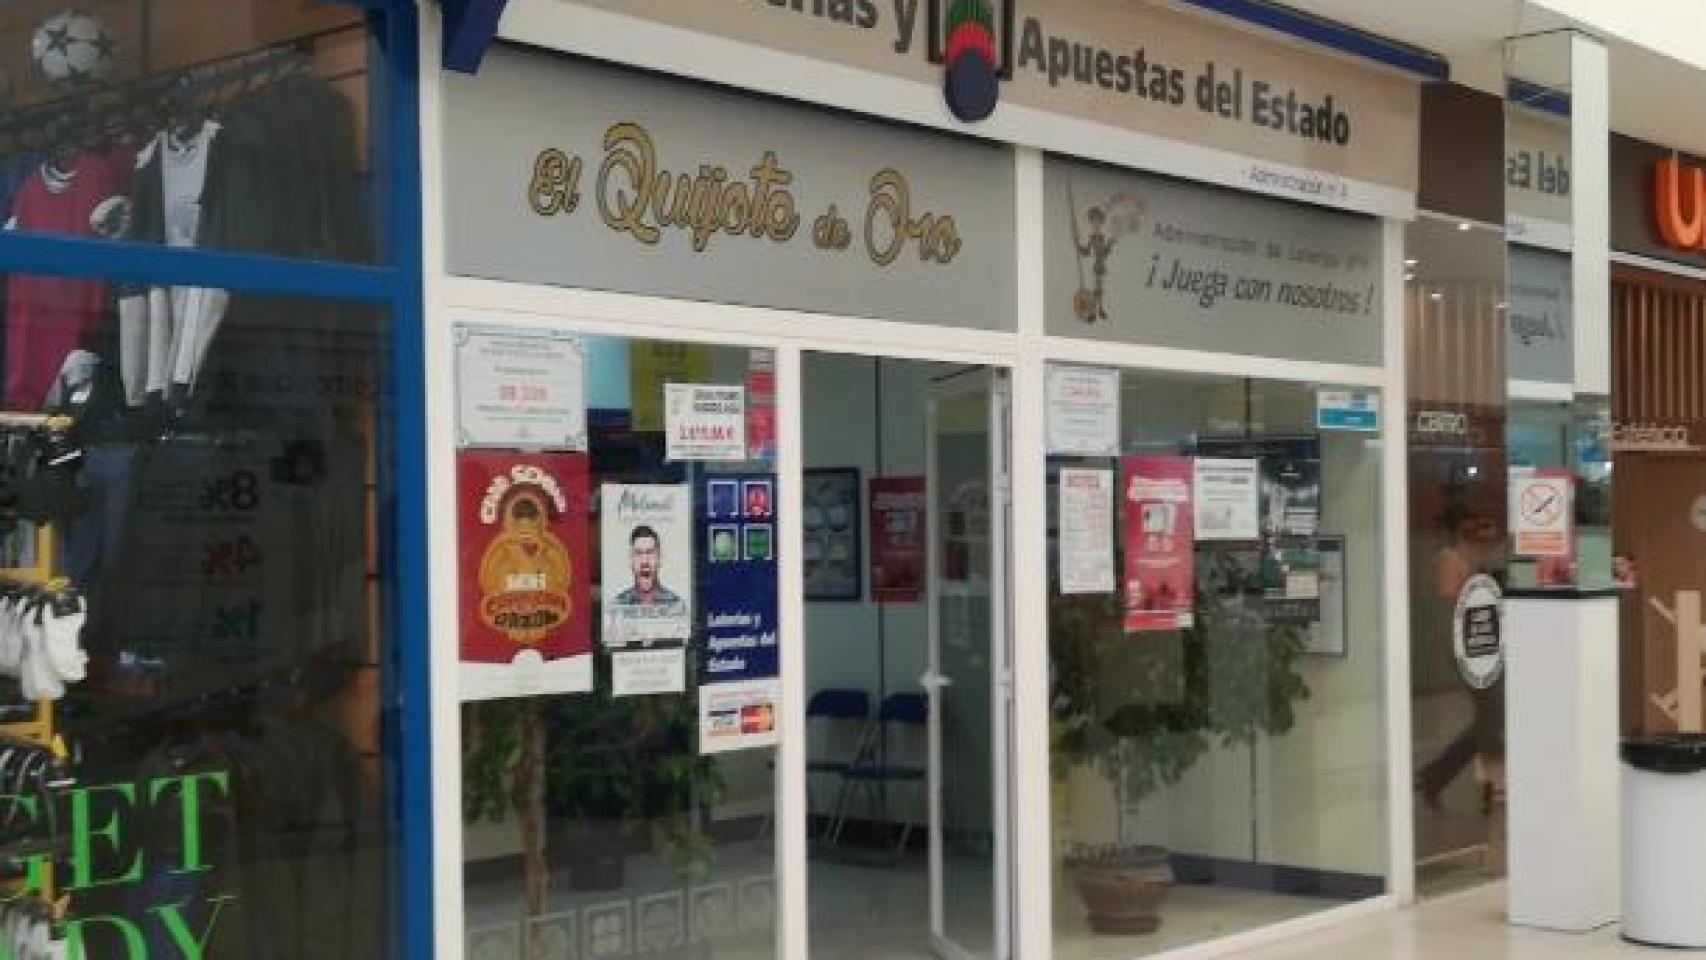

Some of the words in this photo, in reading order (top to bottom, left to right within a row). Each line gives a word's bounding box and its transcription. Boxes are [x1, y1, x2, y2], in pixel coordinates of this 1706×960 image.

[1017, 16, 1185, 107] Apuestas
[1196, 62, 1243, 121] del
[1251, 80, 1350, 146] Estado
[528, 147, 583, 217] El
[596, 121, 801, 253] Quijote
[812, 203, 852, 250] de
[863, 167, 963, 267] Oro
[1161, 257, 1228, 309] Juega
[1234, 275, 1272, 303] con
[1276, 280, 1362, 316] nosotros
